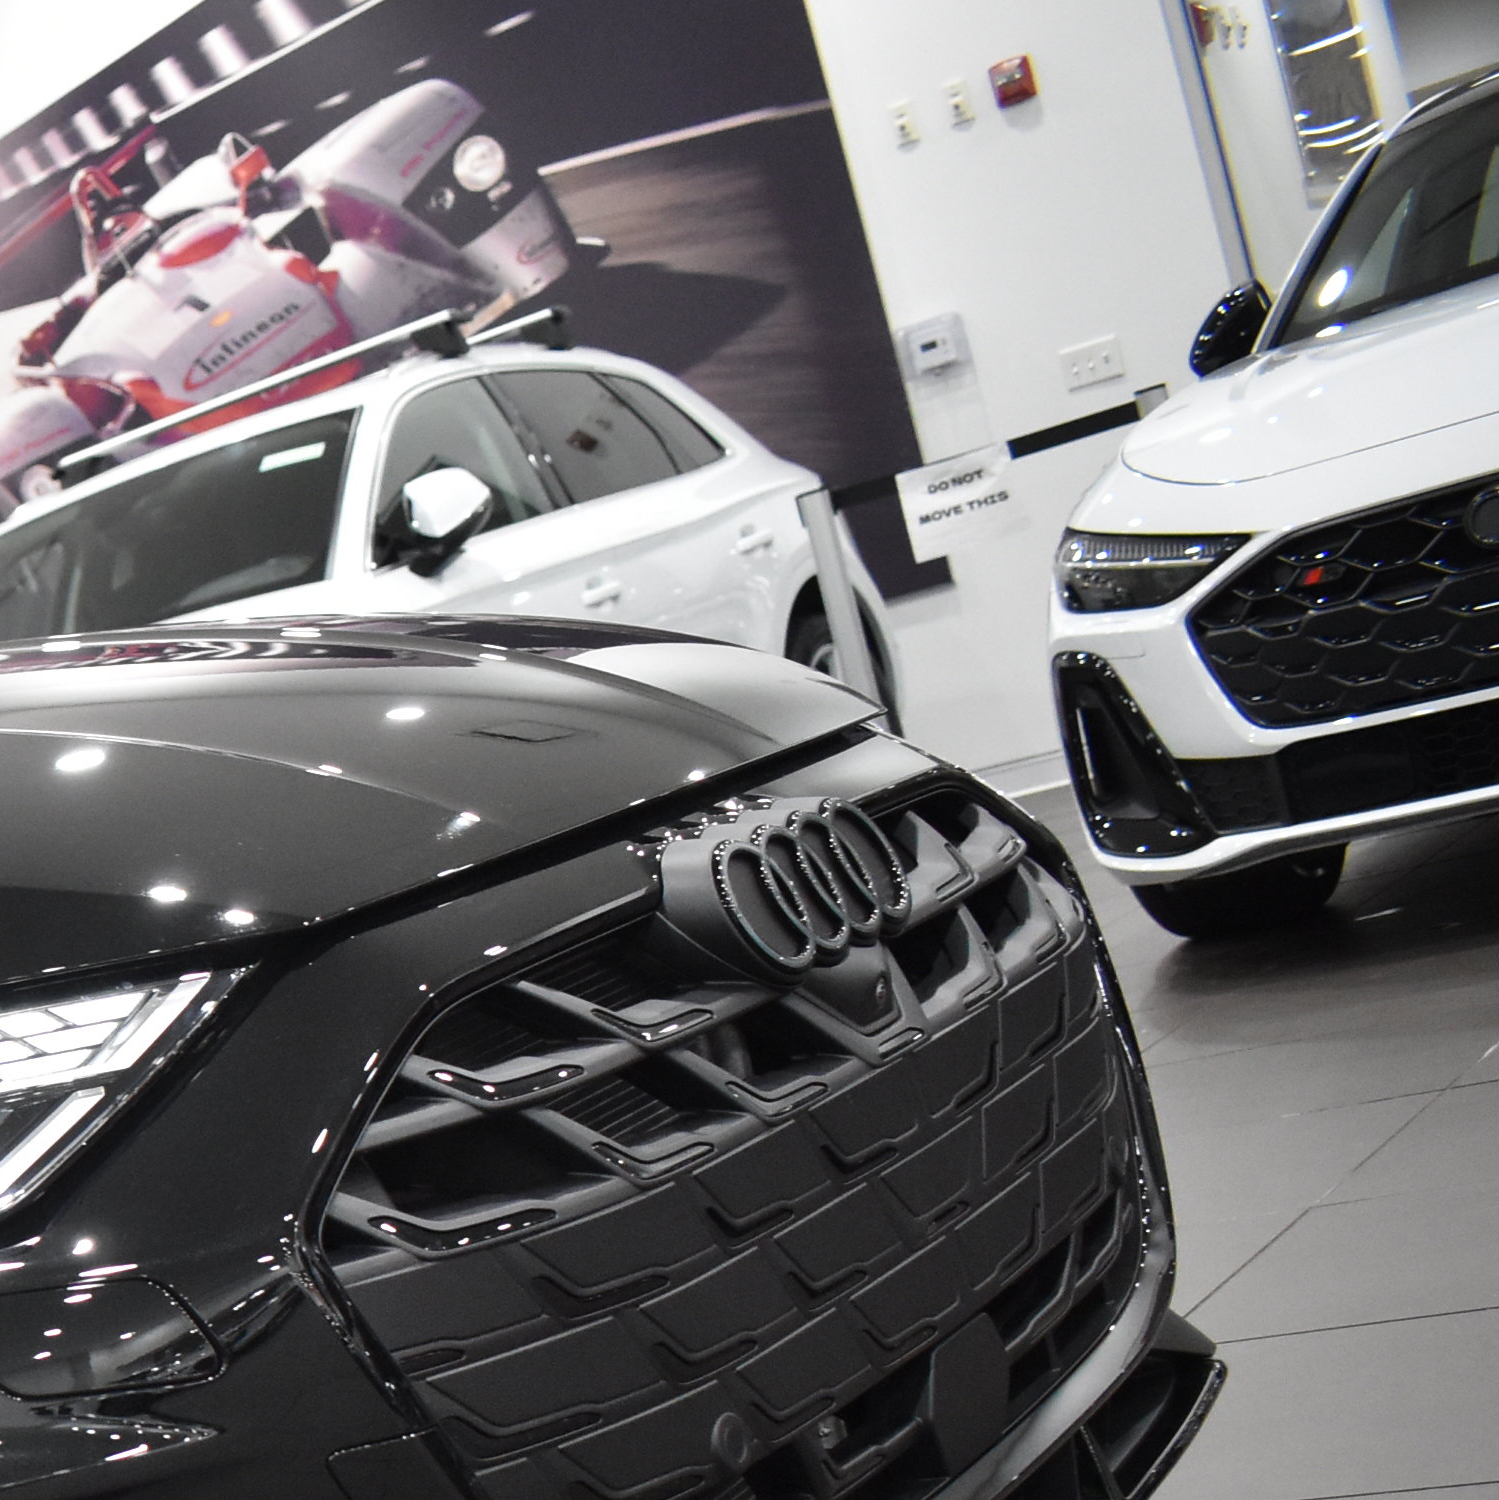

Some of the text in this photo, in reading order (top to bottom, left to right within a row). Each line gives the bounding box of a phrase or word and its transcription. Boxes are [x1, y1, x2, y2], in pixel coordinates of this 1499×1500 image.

[193, 302, 300, 374] Infineon
[927, 468, 985, 494] DO NOT
[919, 490, 1009, 525] MOVE THIS
